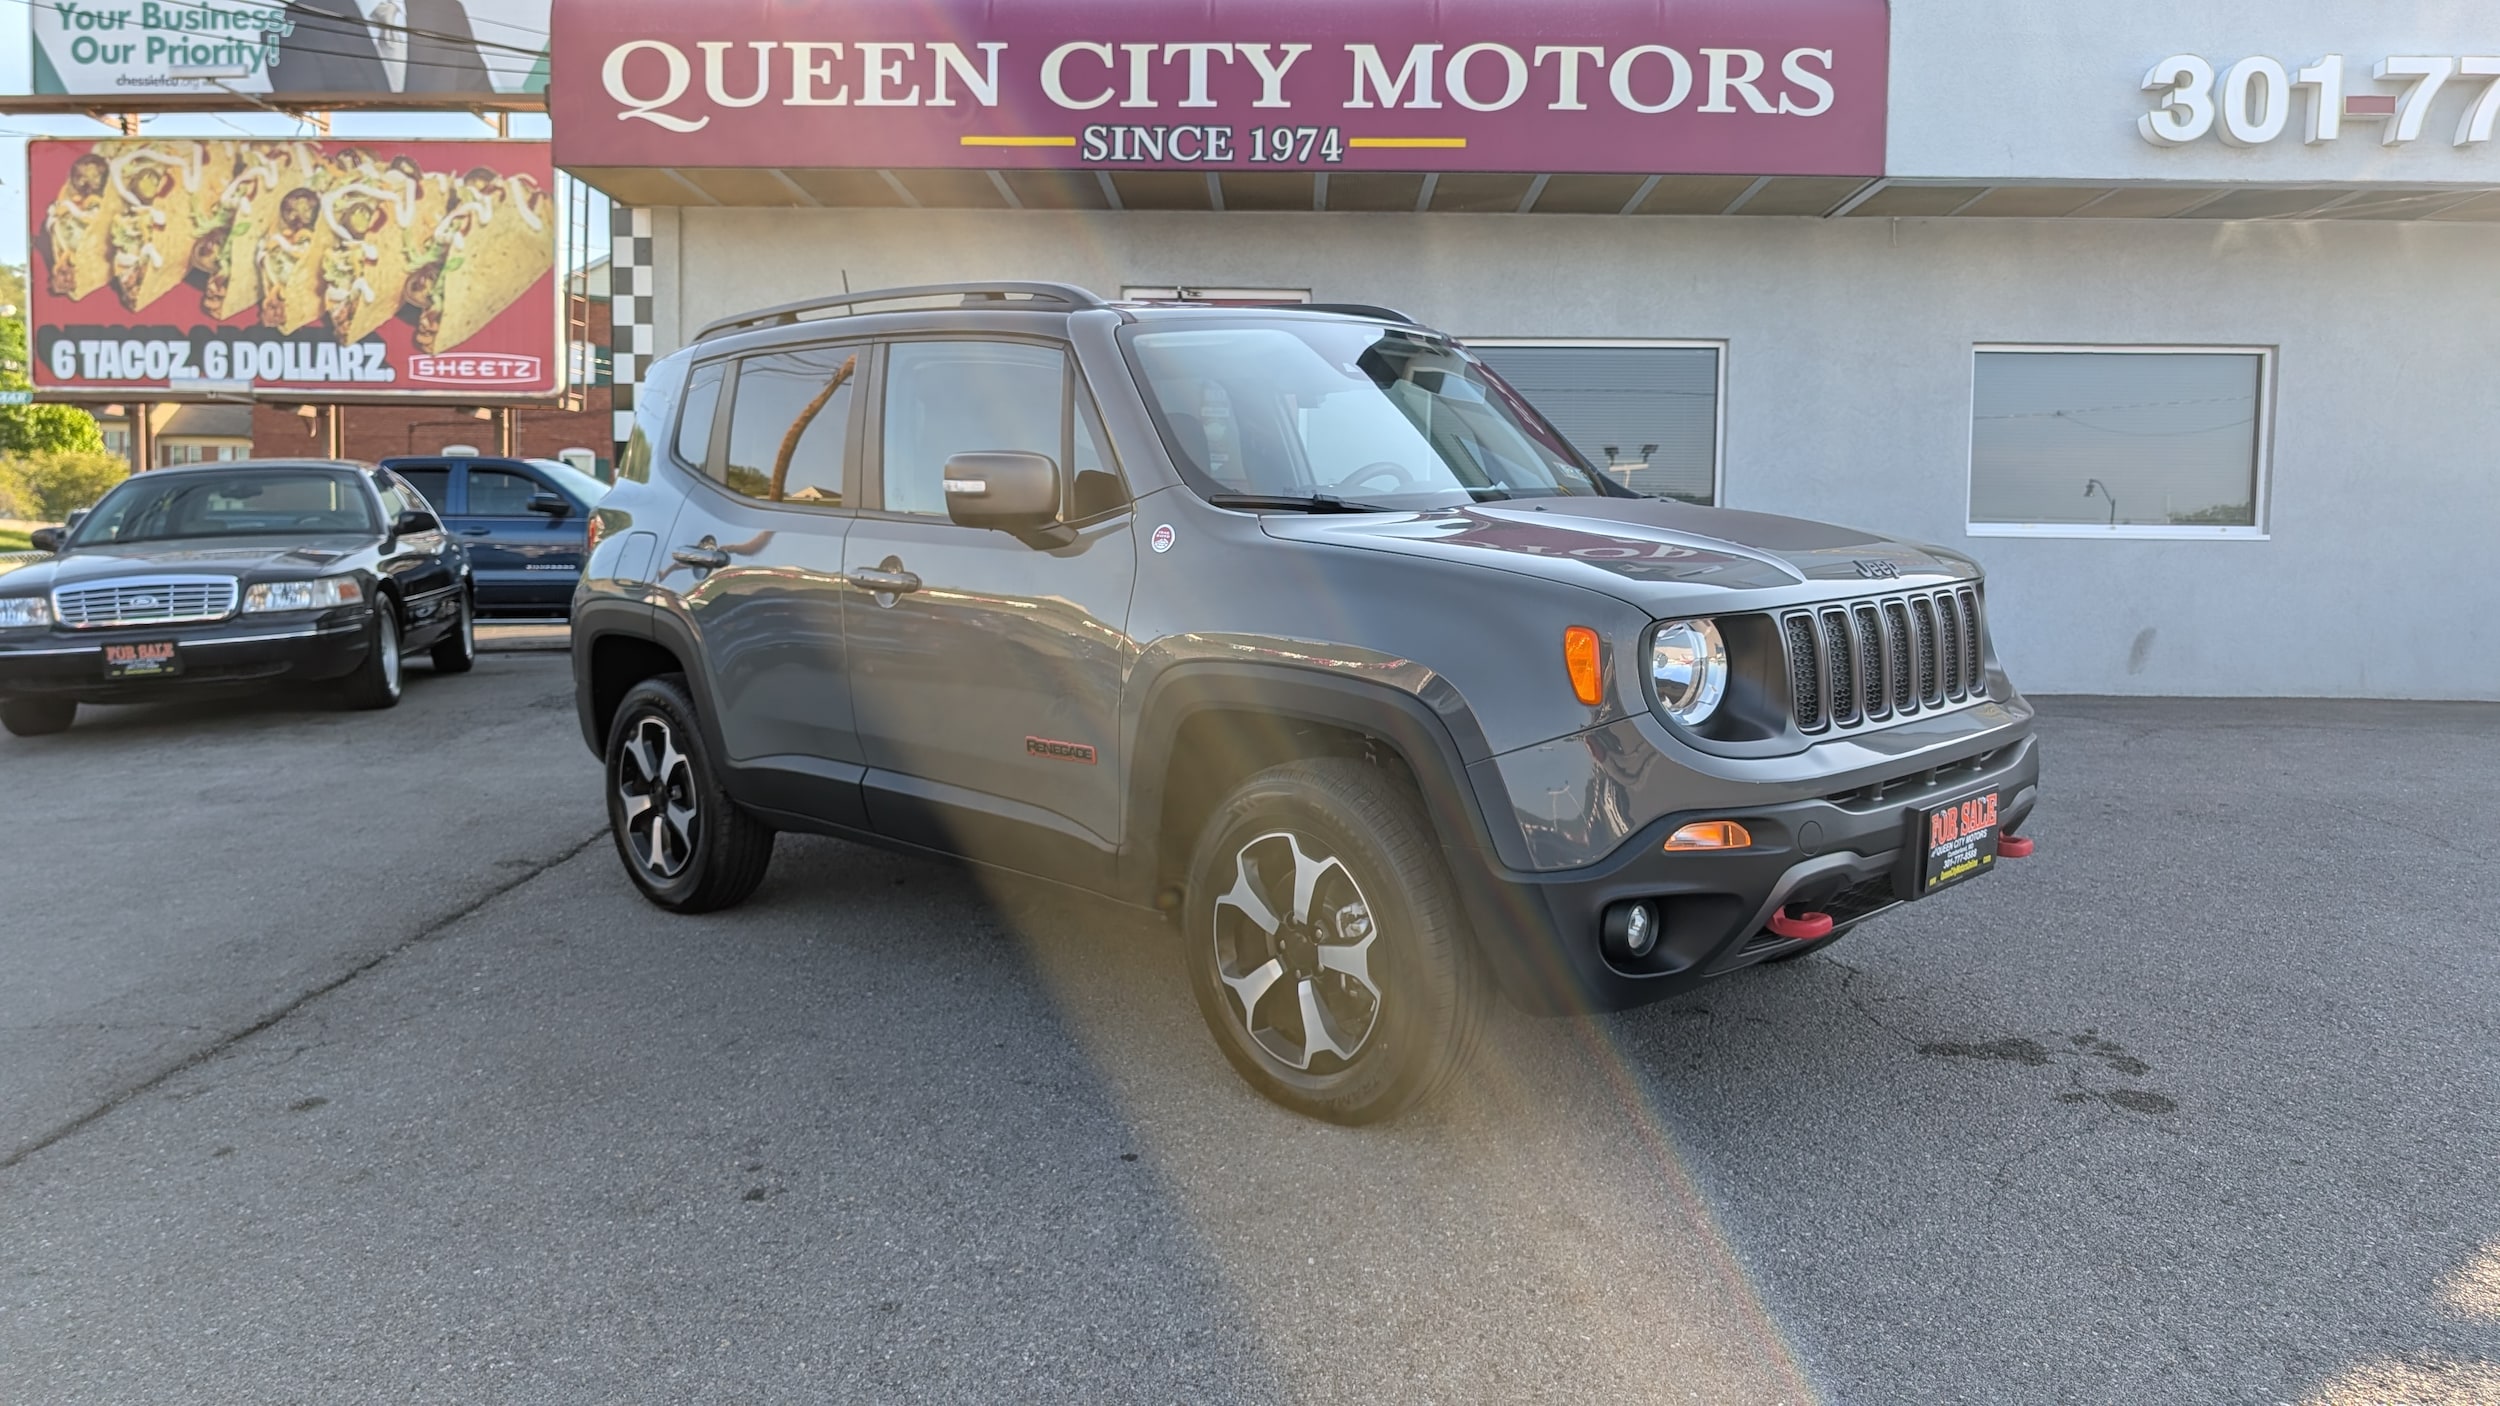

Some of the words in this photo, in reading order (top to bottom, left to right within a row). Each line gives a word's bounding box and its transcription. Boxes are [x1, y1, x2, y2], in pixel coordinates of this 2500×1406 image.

[56, 1, 131, 31] Your
[143, 1, 295, 38] Business,
[71, 36, 136, 65] Our
[146, 33, 281, 74] Priority!
[601, 40, 1008, 133] QUEEN
[1039, 41, 1312, 110] CITY
[1343, 42, 1835, 117] MOTORS
[1081, 124, 1234, 162] SINCE
[1248, 126, 1344, 164] 1974
[52, 340, 77, 380] 6
[79, 340, 199, 380] TACOZ.
[204, 340, 228, 380] 6
[227, 340, 396, 382] DOLLARZ.
[417, 359, 533, 378] SHEETZ
[1852, 560, 1900, 579] Jeep
[1931, 807, 1958, 849] FOR
[1961, 793, 1997, 835] SALE
[1954, 837, 1965, 848] CITY
[1966, 829, 1988, 844] MOTORS
